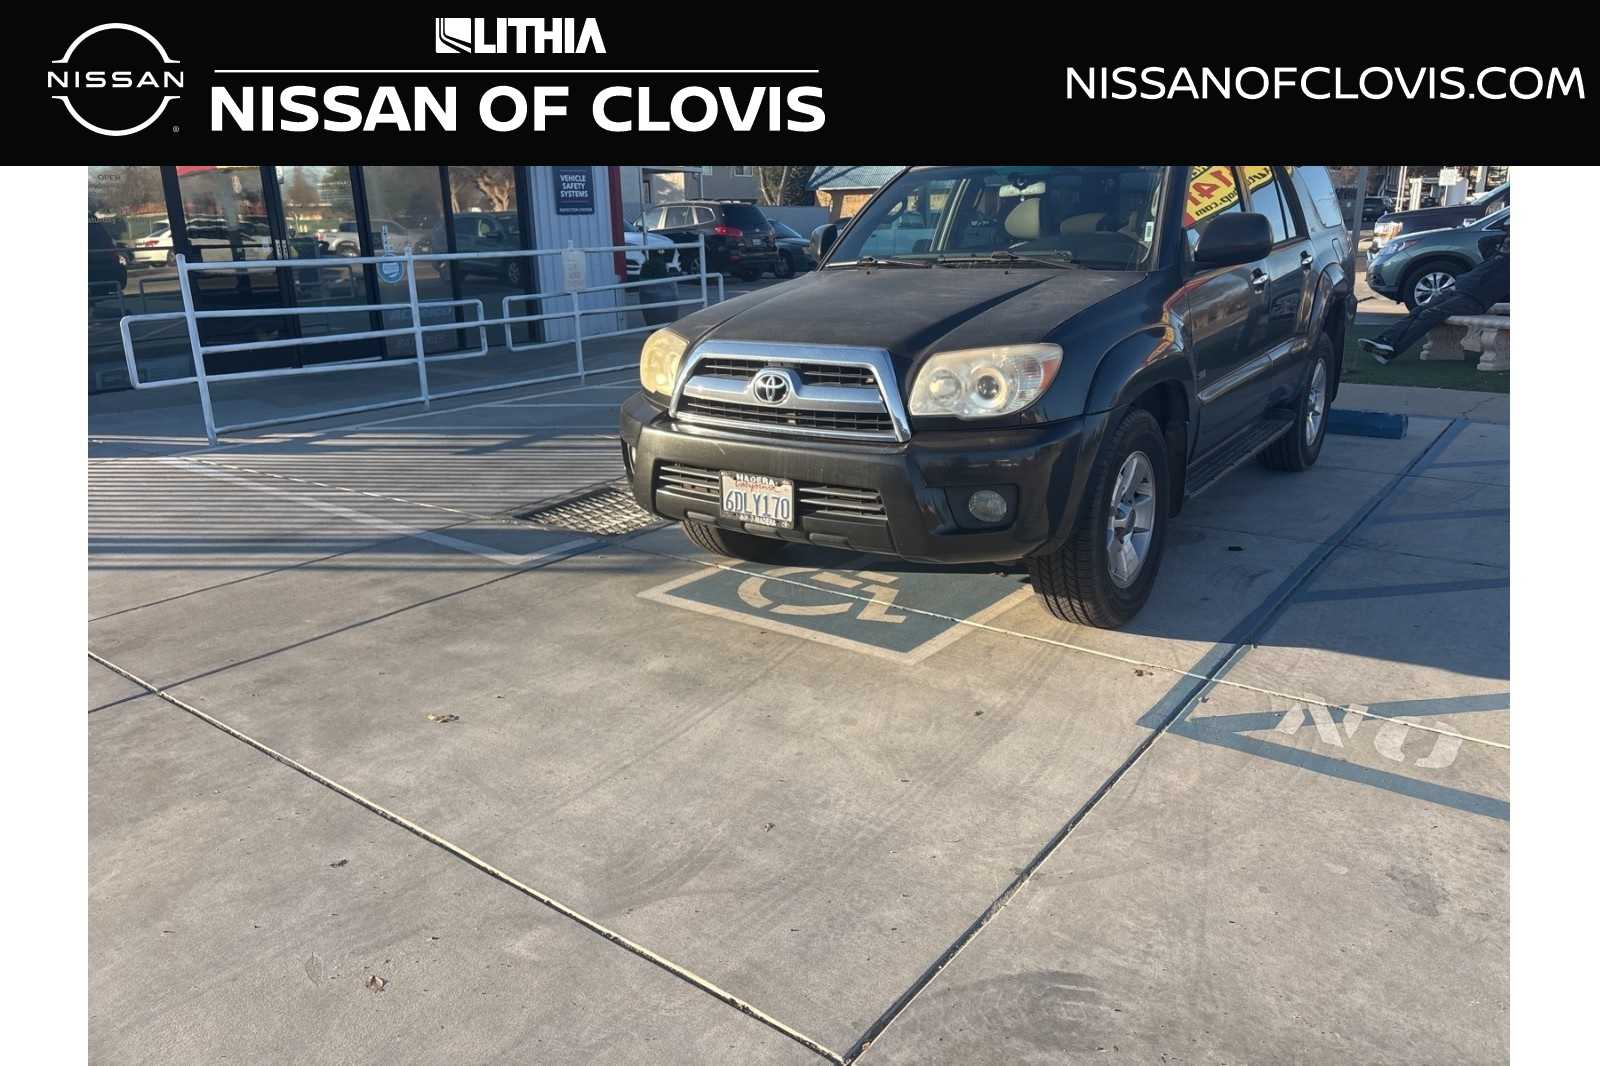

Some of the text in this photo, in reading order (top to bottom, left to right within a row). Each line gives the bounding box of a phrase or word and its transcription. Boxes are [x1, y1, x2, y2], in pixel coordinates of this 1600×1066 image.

[560, 174, 586, 182] VEHICLE
[562, 182, 585, 190] SAFETY
[560, 190, 589, 198] SYSTEMS
[725, 489, 790, 520] 6DLY170
[1274, 692, 1464, 769] NO
